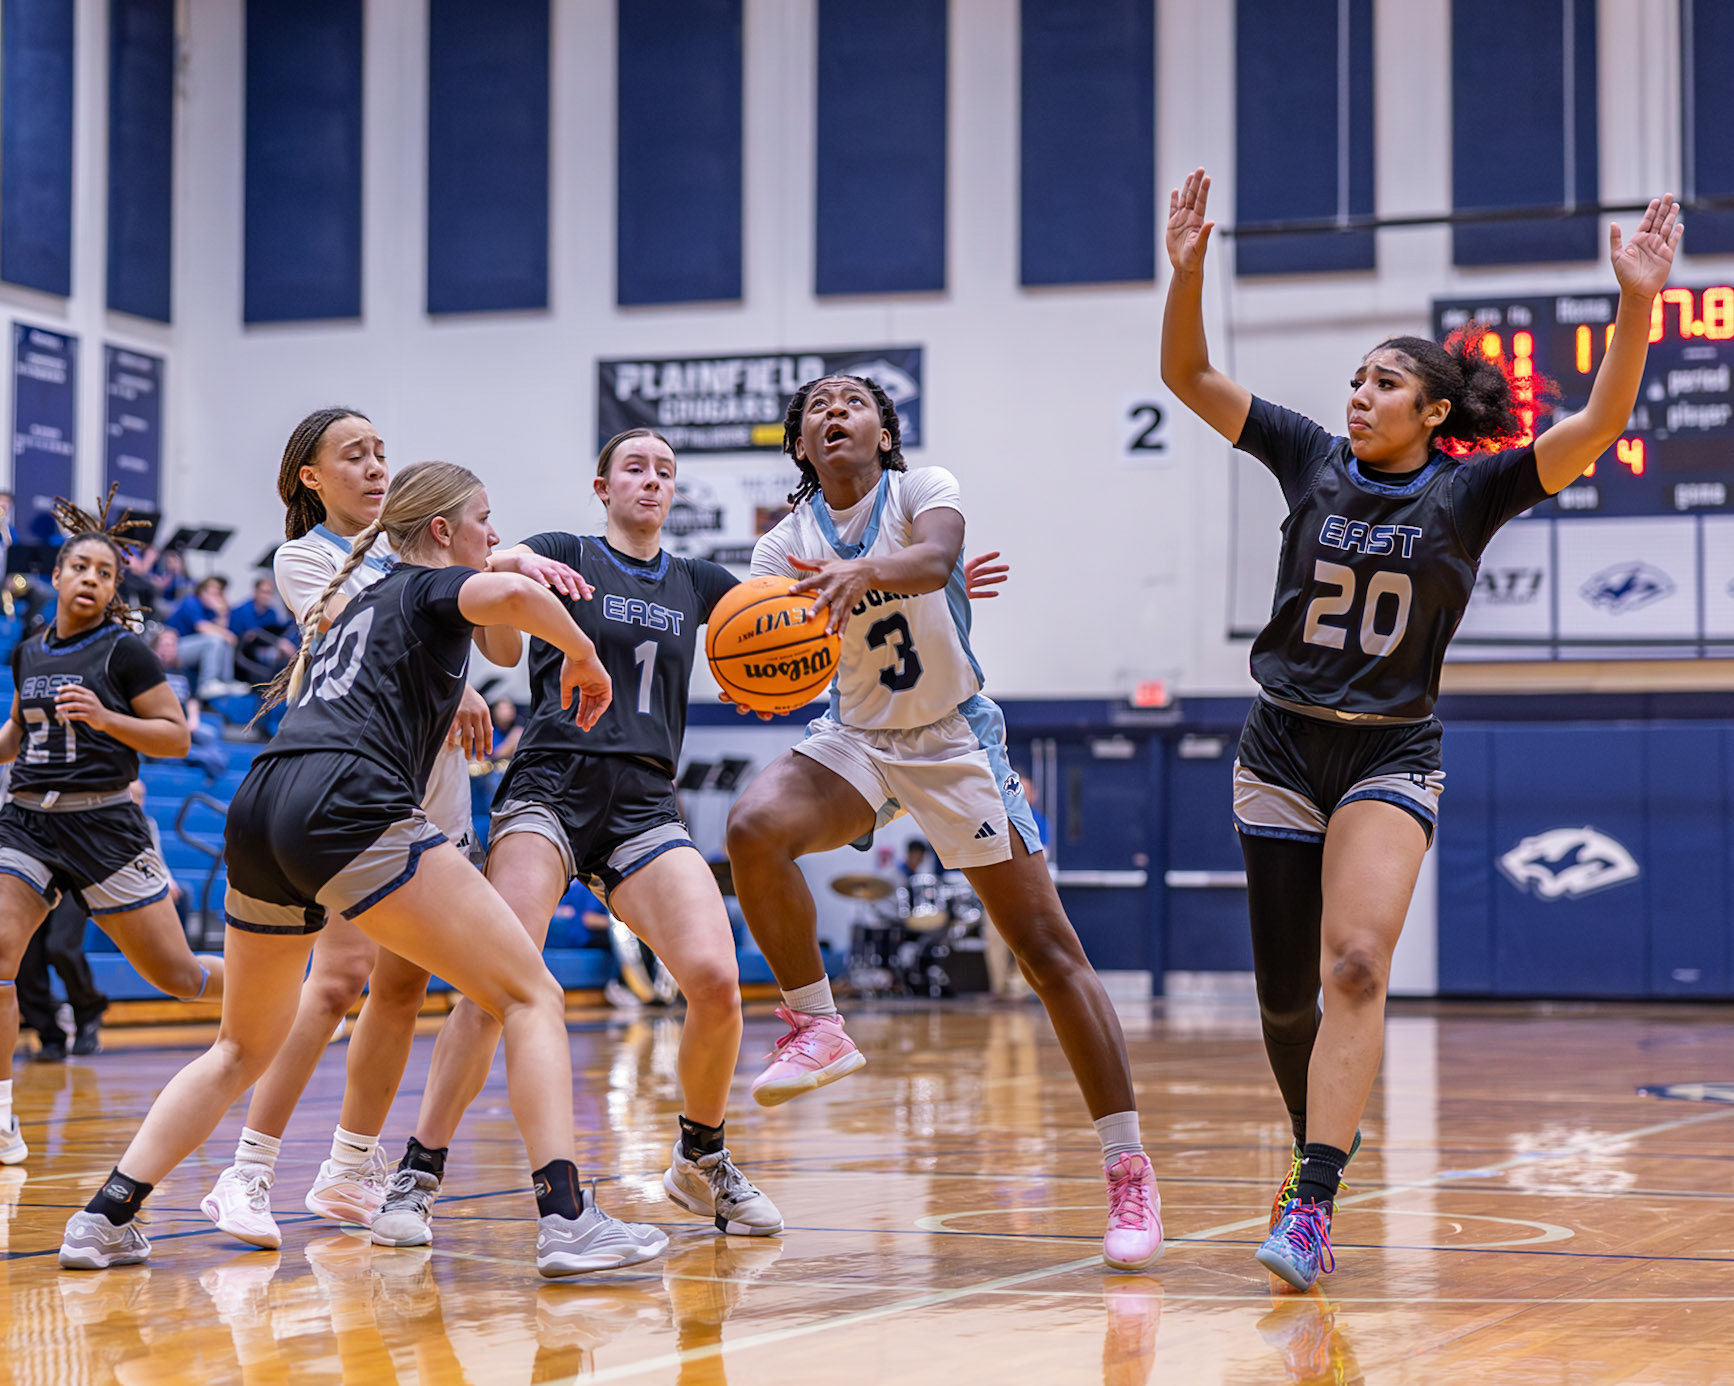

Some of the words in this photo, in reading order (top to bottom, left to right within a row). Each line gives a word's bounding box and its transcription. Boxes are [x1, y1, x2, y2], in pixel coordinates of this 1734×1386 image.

[615, 355, 826, 401] PLAINFIELD
[1127, 402, 1166, 453] 2
[1617, 438, 1645, 476] 4
[1319, 514, 1423, 559] EAST
[603, 594, 684, 636] EAST
[1303, 559, 1413, 658] 20
[743, 646, 833, 681] Wilson
[864, 611, 924, 694] 3
[21, 674, 83, 700] EAST
[634, 640, 659, 714] 1
[22, 708, 77, 764] 21
